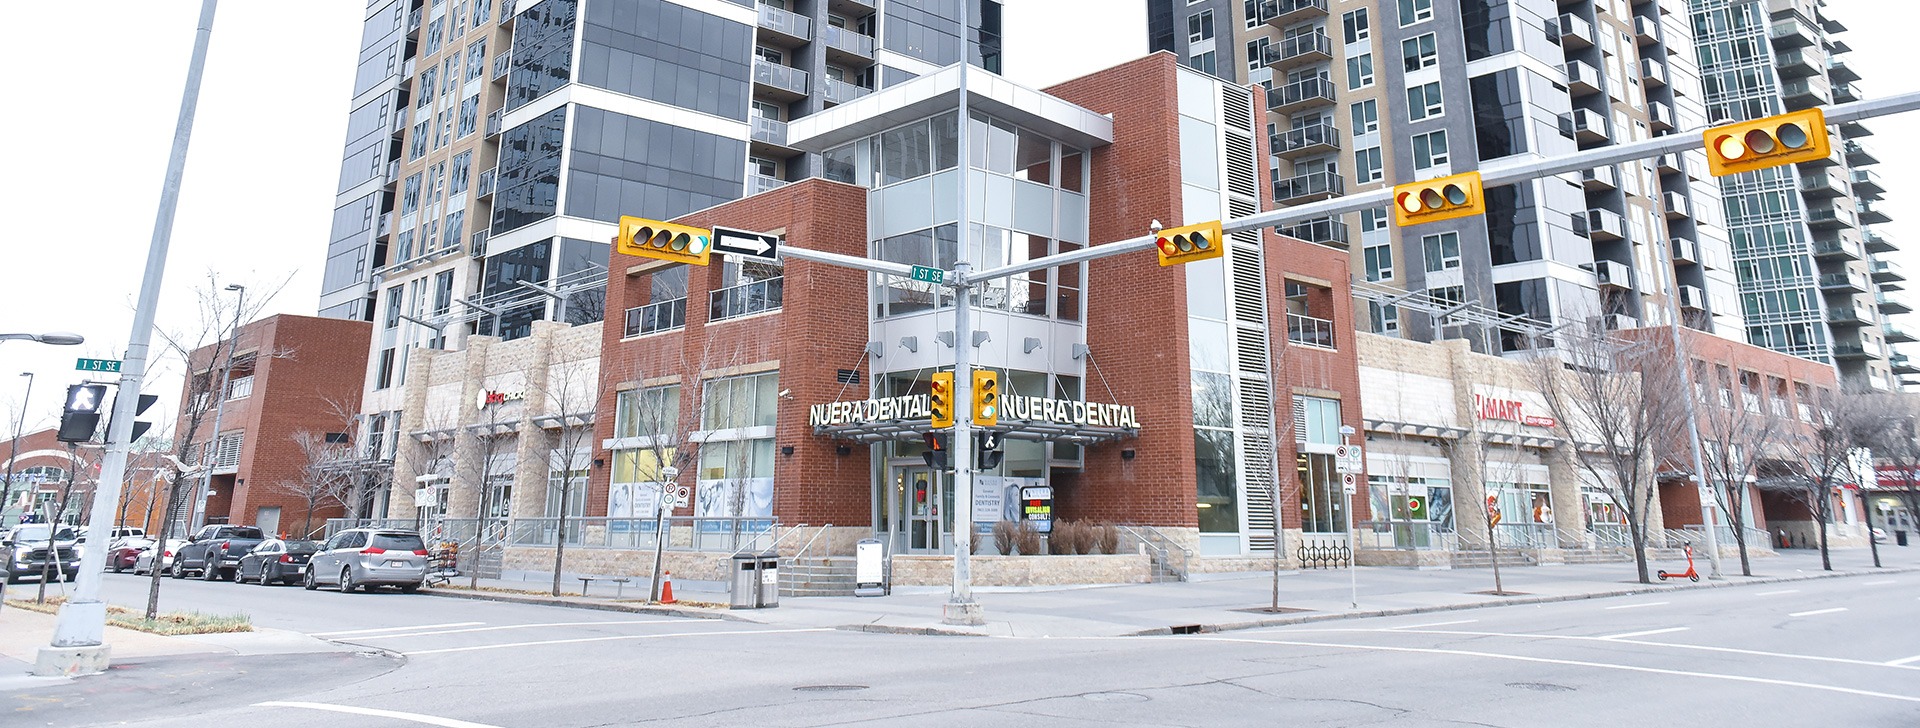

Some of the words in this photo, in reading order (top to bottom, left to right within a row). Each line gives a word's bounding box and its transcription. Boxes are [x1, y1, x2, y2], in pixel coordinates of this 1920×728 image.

[919, 268, 929, 280] ST
[931, 270, 942, 282] SE
[92, 360, 102, 370] ST
[106, 361, 116, 371] SE
[809, 401, 864, 426] NUERA
[867, 393, 932, 421] DENTAL
[1001, 394, 1070, 423] NUERA
[1073, 401, 1141, 428] DENTAL
[1487, 398, 1522, 422] MART
